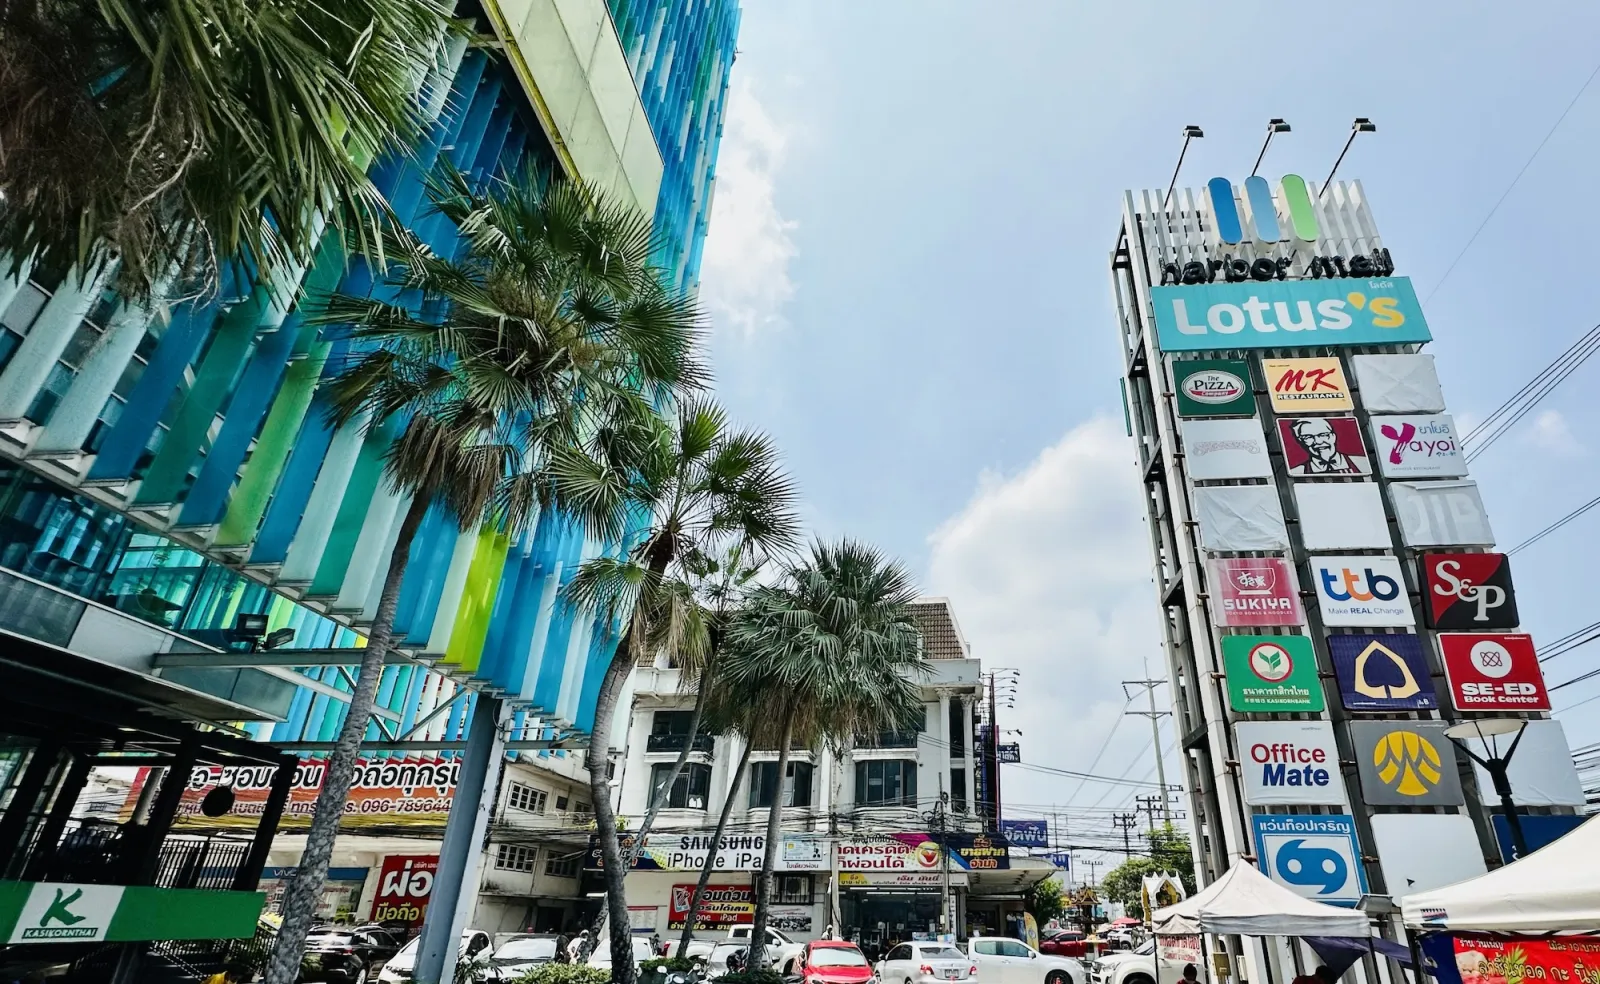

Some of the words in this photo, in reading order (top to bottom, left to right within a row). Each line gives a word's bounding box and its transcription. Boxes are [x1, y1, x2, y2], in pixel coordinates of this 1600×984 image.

[1159, 253, 1292, 286] harbor
[1309, 248, 1394, 279] mall
[1171, 292, 1405, 336] Lotus's
[1194, 380, 1234, 390] PIZZA
[1275, 368, 1339, 392] MK
[1419, 421, 1450, 434] ยาโยอิ
[1381, 422, 1456, 465] Yayoi
[1320, 568, 1400, 601] ttb
[1434, 560, 1506, 621] S&P
[1223, 597, 1292, 610] SUKIYA
[1373, 607, 1405, 615] Change
[1242, 685, 1309, 695] ธนาคารกสิกรไทย
[1461, 682, 1537, 695] SE-ED
[1463, 695, 1497, 703] Book
[1497, 695, 1539, 703] Center
[1251, 743, 1326, 763] Office
[1262, 763, 1330, 786] Mate
[1259, 819, 1351, 833] แว่นท็อปเจริญ
[680, 836, 764, 850] SAMSUNG
[735, 853, 763, 868] iPa
[375, 902, 420, 921] มือถือ
[719, 913, 738, 921] iPad
[24, 929, 96, 938] KASIKORNTHAI
